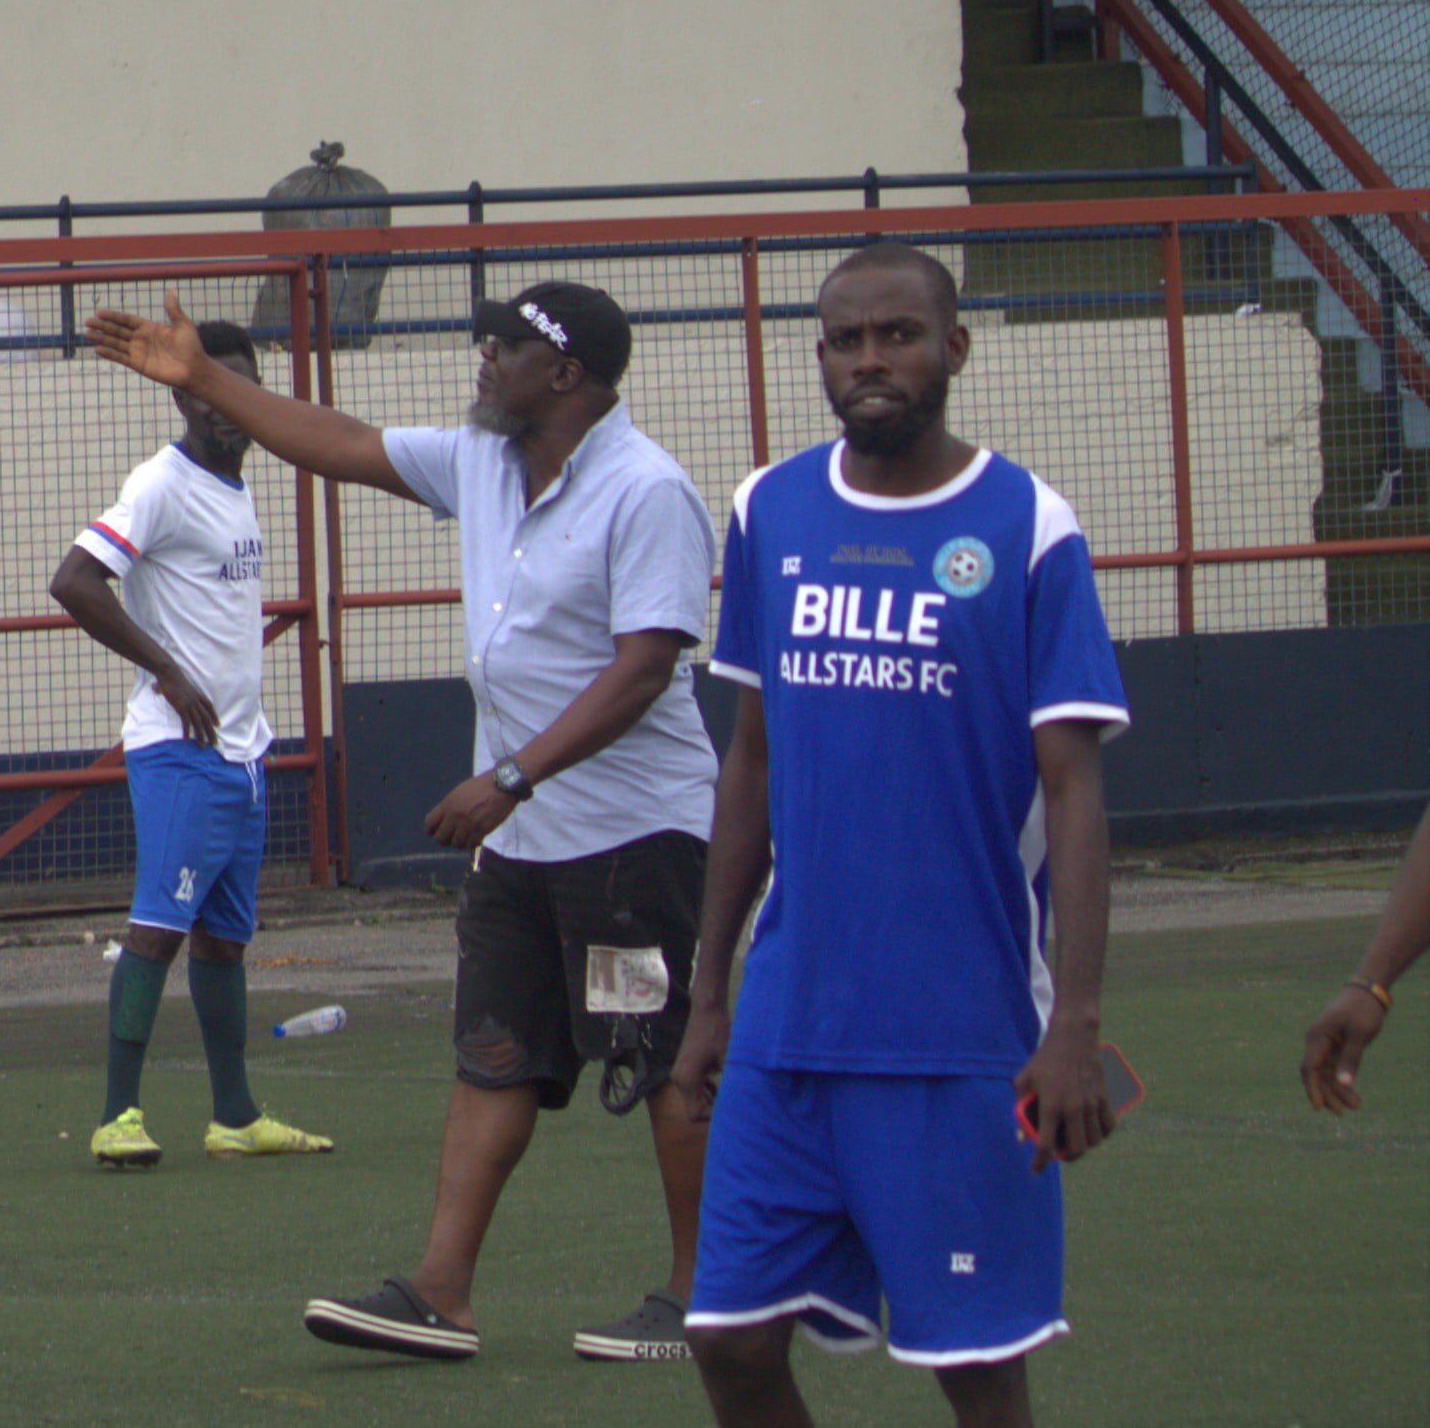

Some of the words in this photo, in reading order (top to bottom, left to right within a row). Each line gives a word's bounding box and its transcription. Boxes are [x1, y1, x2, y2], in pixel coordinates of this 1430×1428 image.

[792, 584, 946, 646] BILLE
[780, 651, 914, 691] ALLSTARS
[920, 661, 958, 697] FC
[174, 866, 197, 902] 26
[634, 1340, 687, 1358] crocs
